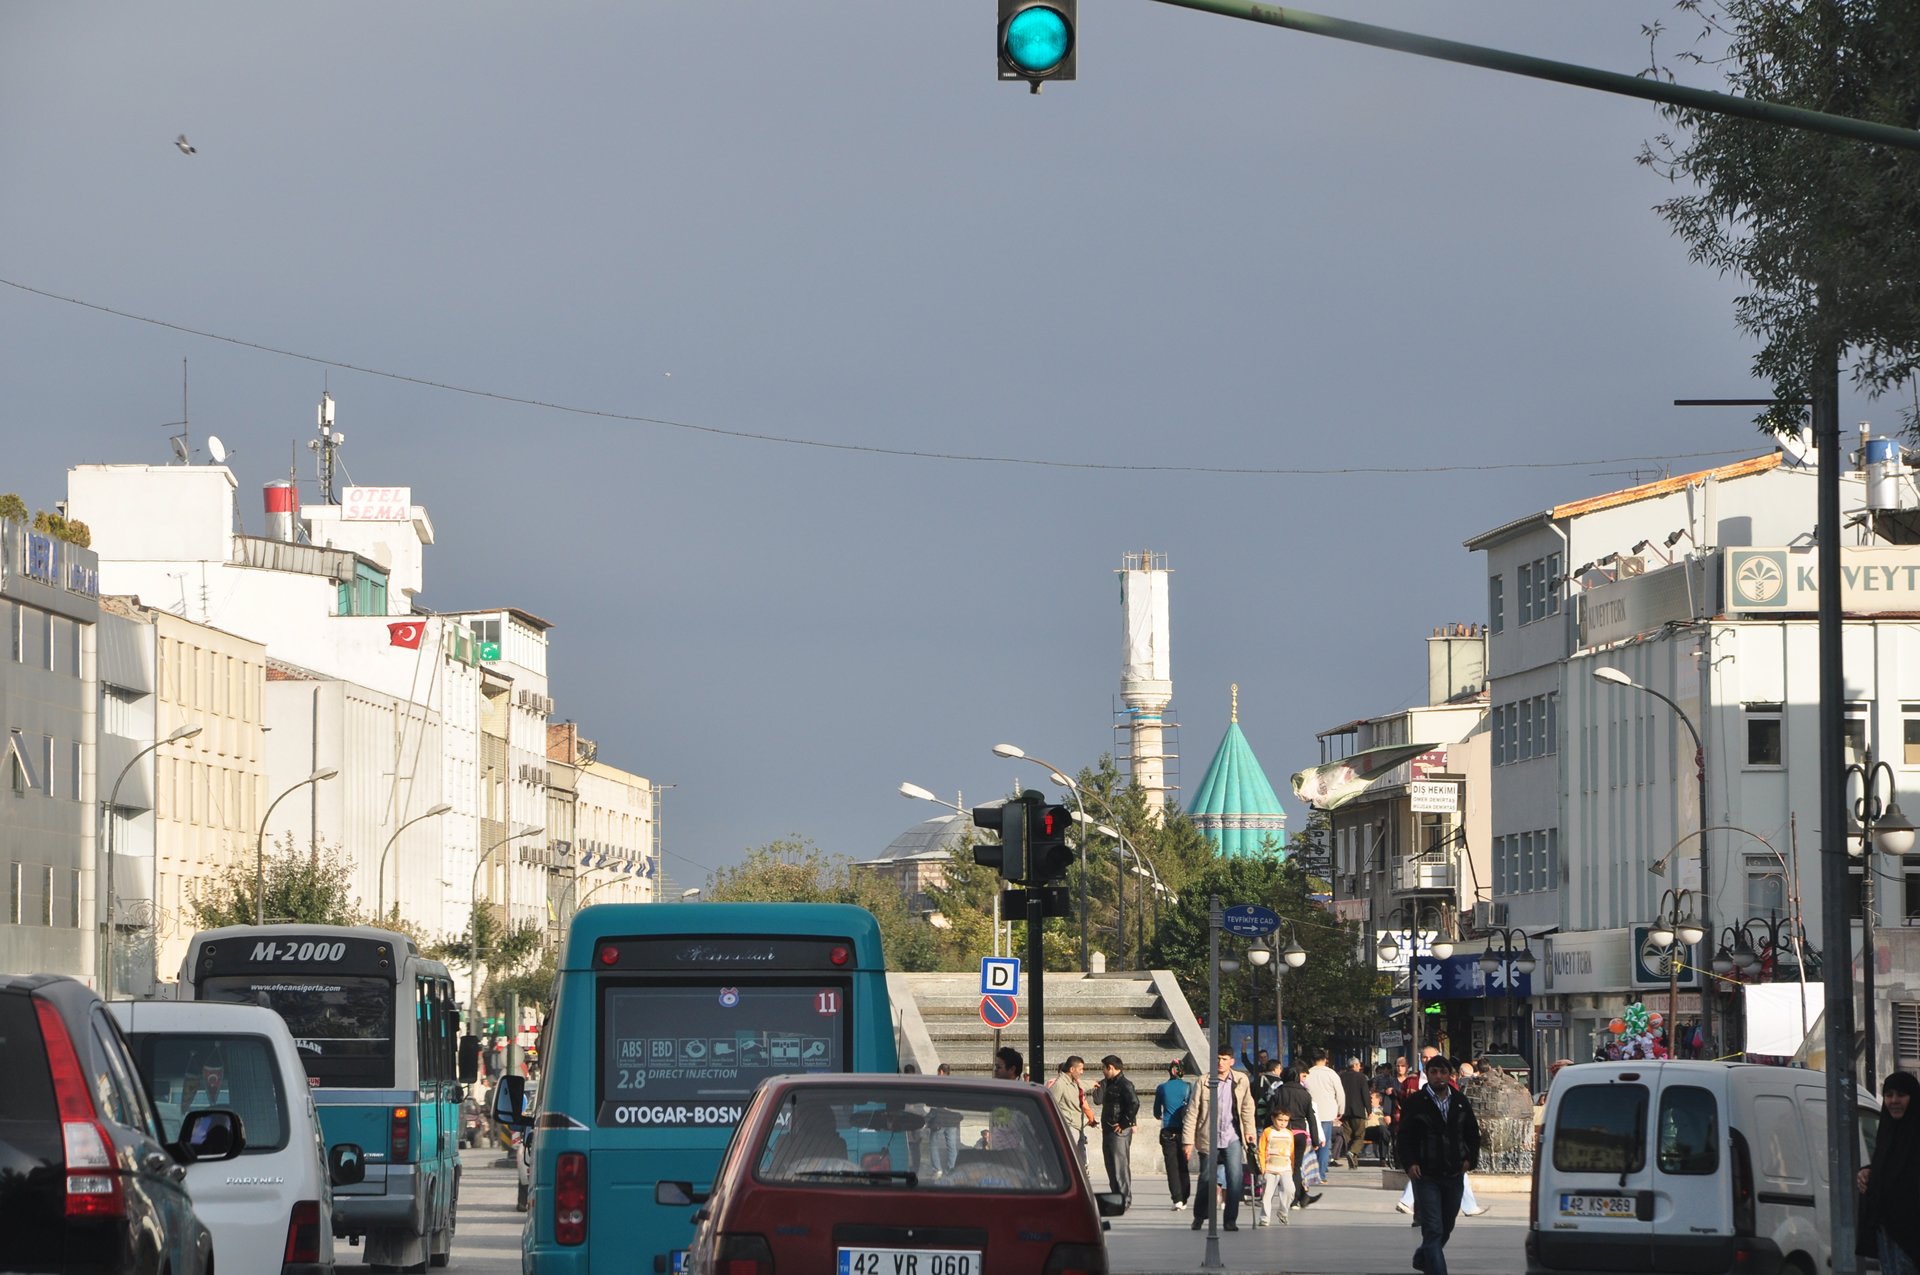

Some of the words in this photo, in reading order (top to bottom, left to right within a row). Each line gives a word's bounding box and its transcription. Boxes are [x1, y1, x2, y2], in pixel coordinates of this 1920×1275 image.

[349, 489, 404, 502] OTEL
[346, 506, 406, 519] SEMA
[1797, 566, 1920, 591] KVEYT
[249, 942, 347, 961] M-2000
[992, 966, 1009, 987] D
[251, 984, 341, 993] www.efecansigorta.com
[818, 992, 837, 1013] 11
[297, 1040, 322, 1055] LLAH
[621, 1041, 642, 1058] ABS
[652, 1041, 673, 1058] EBD
[617, 1070, 647, 1089] 2.8
[648, 1069, 684, 1079] DIRECT
[685, 1069, 738, 1079] INJECTION
[615, 1106, 742, 1124] OTOGAR-BOSN
[226, 1176, 285, 1185] PARTNER
[854, 1253, 879, 1275] 42
[893, 1254, 918, 1275] VR
[931, 1255, 970, 1275] 060
